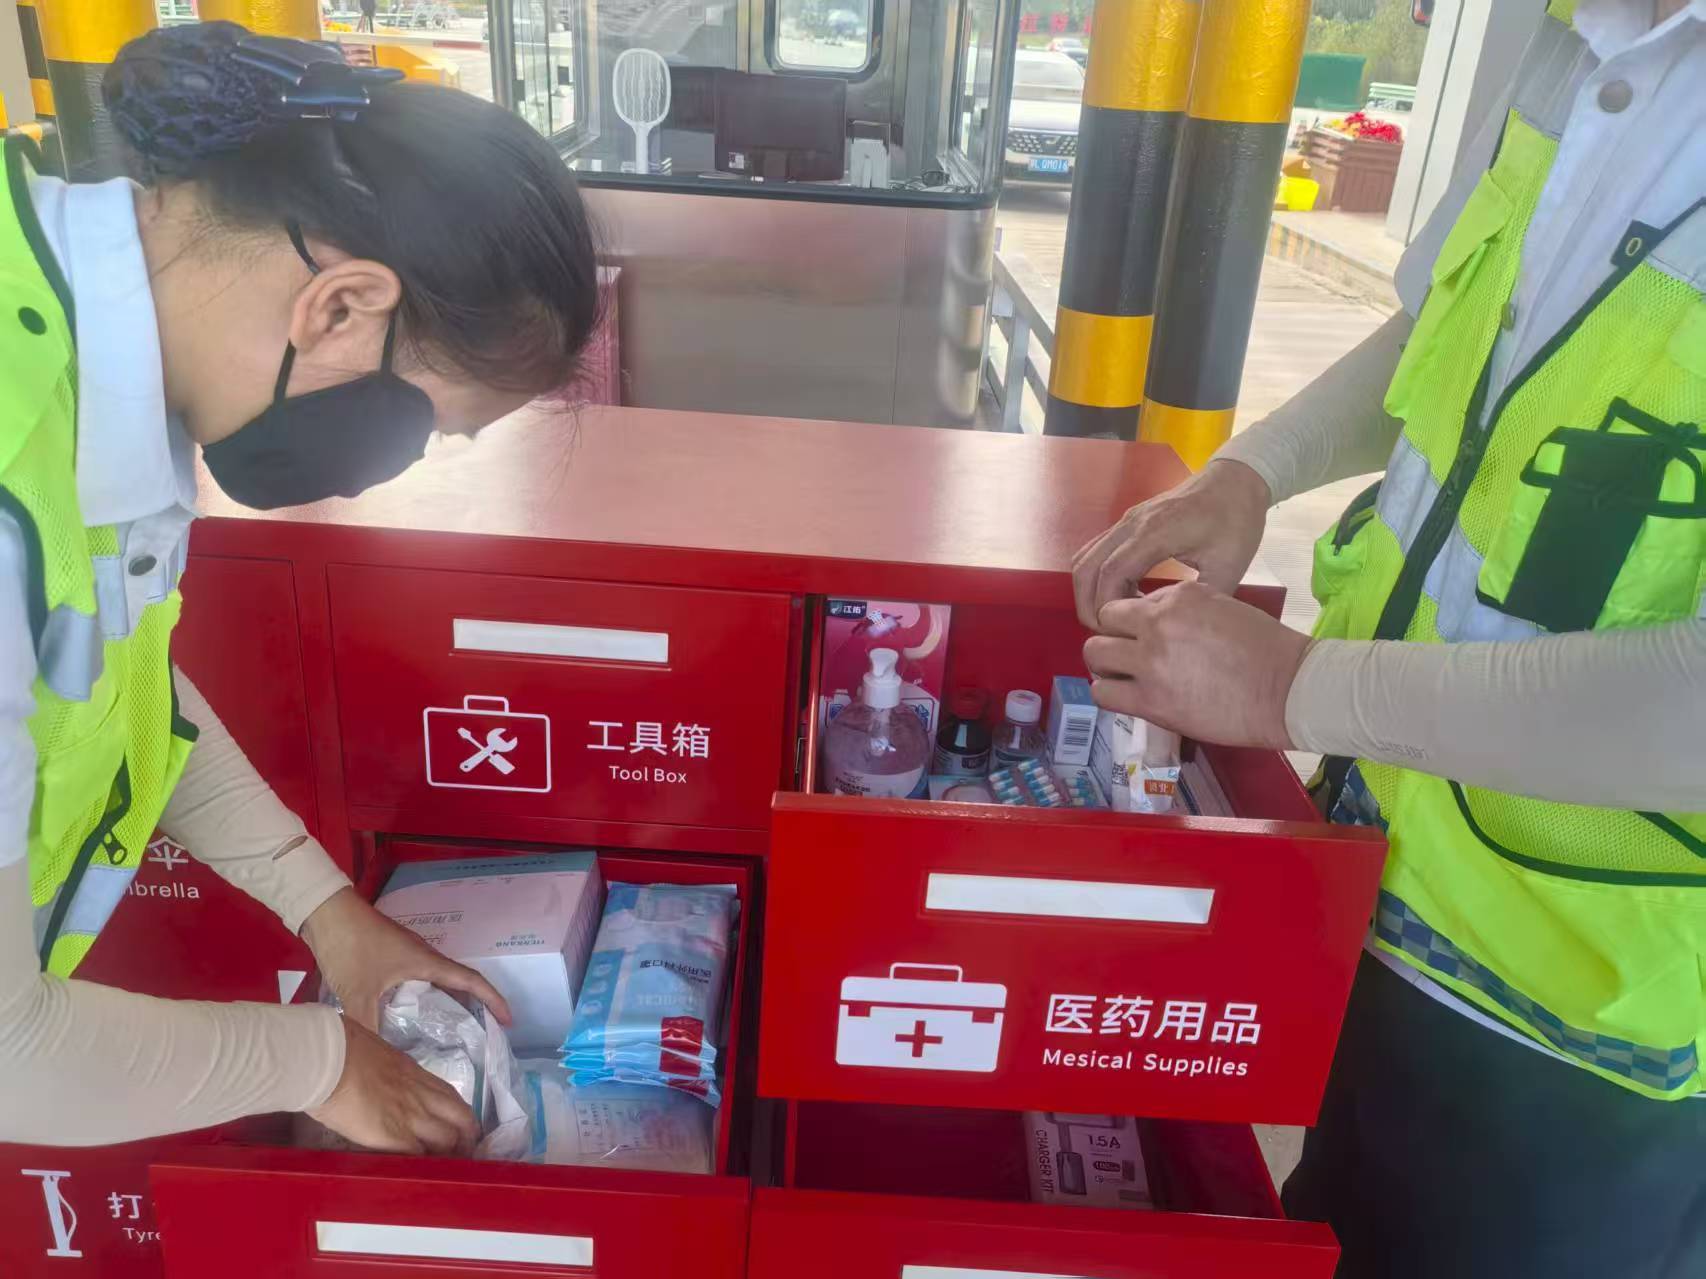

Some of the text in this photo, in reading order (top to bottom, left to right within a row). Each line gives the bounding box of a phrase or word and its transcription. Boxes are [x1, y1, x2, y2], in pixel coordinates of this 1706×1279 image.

[587, 721, 711, 758] 工具箱
[609, 766, 687, 783] Tool Box
[147, 835, 189, 871] 伞
[1045, 993, 1261, 1045] 医药用品
[1042, 1048, 1248, 1077] Mesical Supplies
[1036, 1129, 1054, 1194] CHARGER KIT
